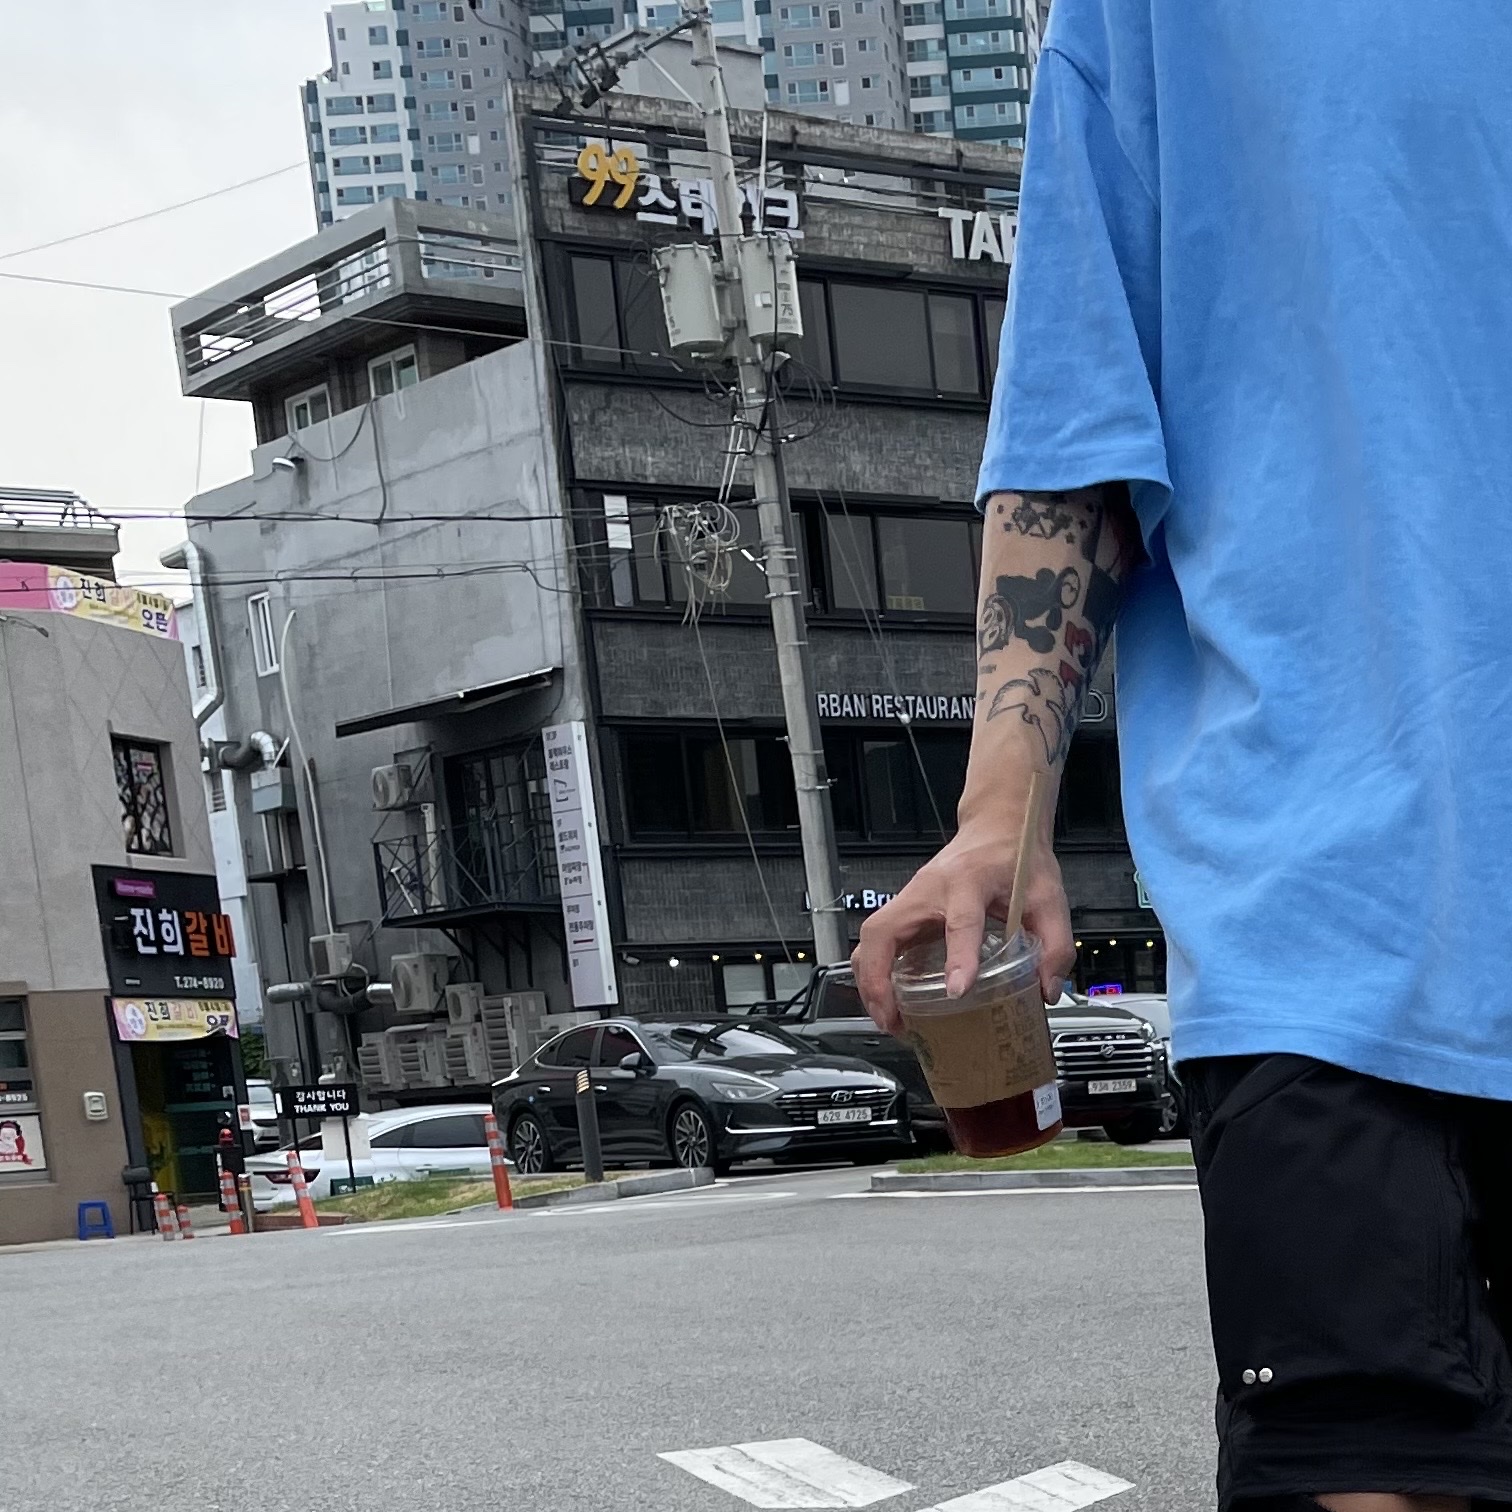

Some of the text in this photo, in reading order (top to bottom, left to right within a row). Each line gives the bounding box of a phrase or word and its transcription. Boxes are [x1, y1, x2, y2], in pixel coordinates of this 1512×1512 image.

[816, 693, 977, 719] RBAN RESTAURAN
[130, 907, 234, 958] 진희갈비
[295, 1089, 346, 1103] 감사합니다
[293, 1102, 349, 1113] THANK YOU
